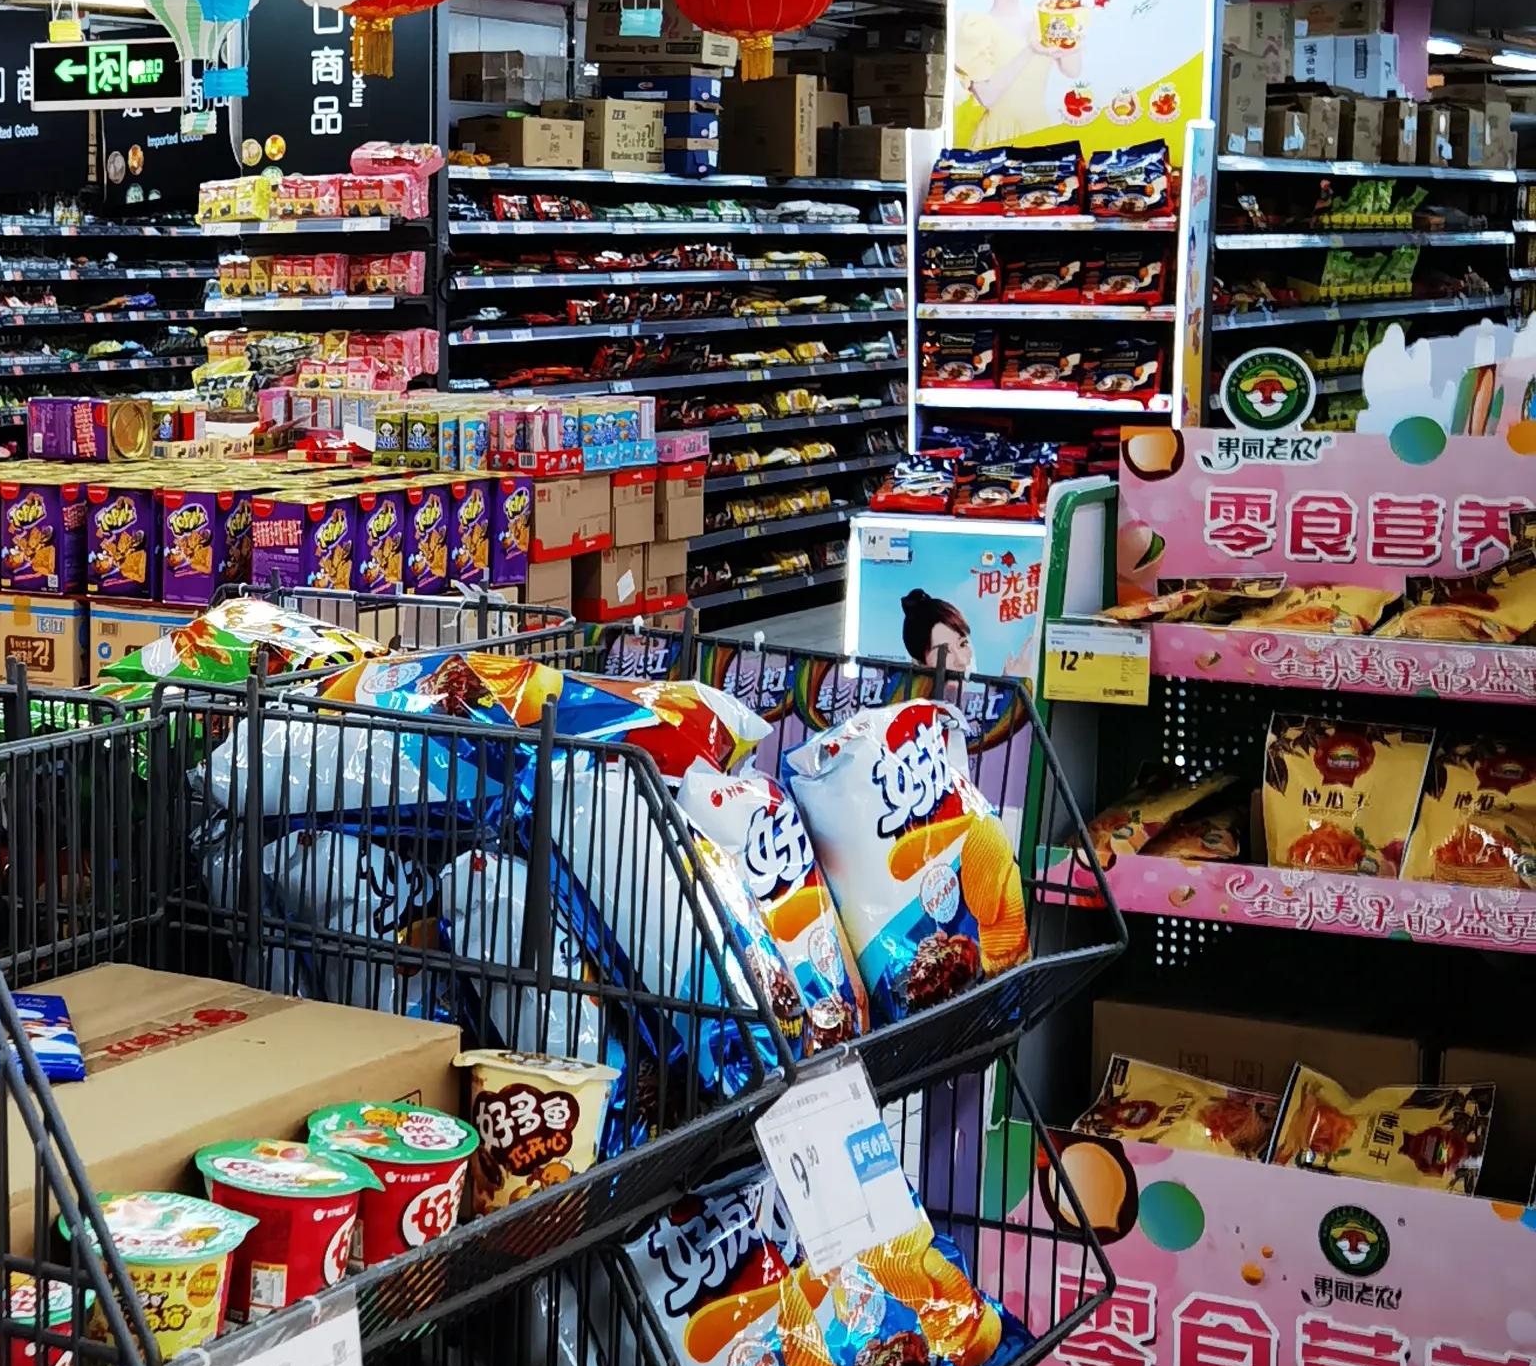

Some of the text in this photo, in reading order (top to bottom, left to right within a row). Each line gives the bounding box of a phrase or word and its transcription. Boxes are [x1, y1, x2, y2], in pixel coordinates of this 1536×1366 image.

[14, 125, 39, 140] Goods
[1204, 483, 1520, 572] 零食营养
[1252, 637, 1536, 697] 全球美果的盛
[476, 1091, 574, 1144] 好多鱼
